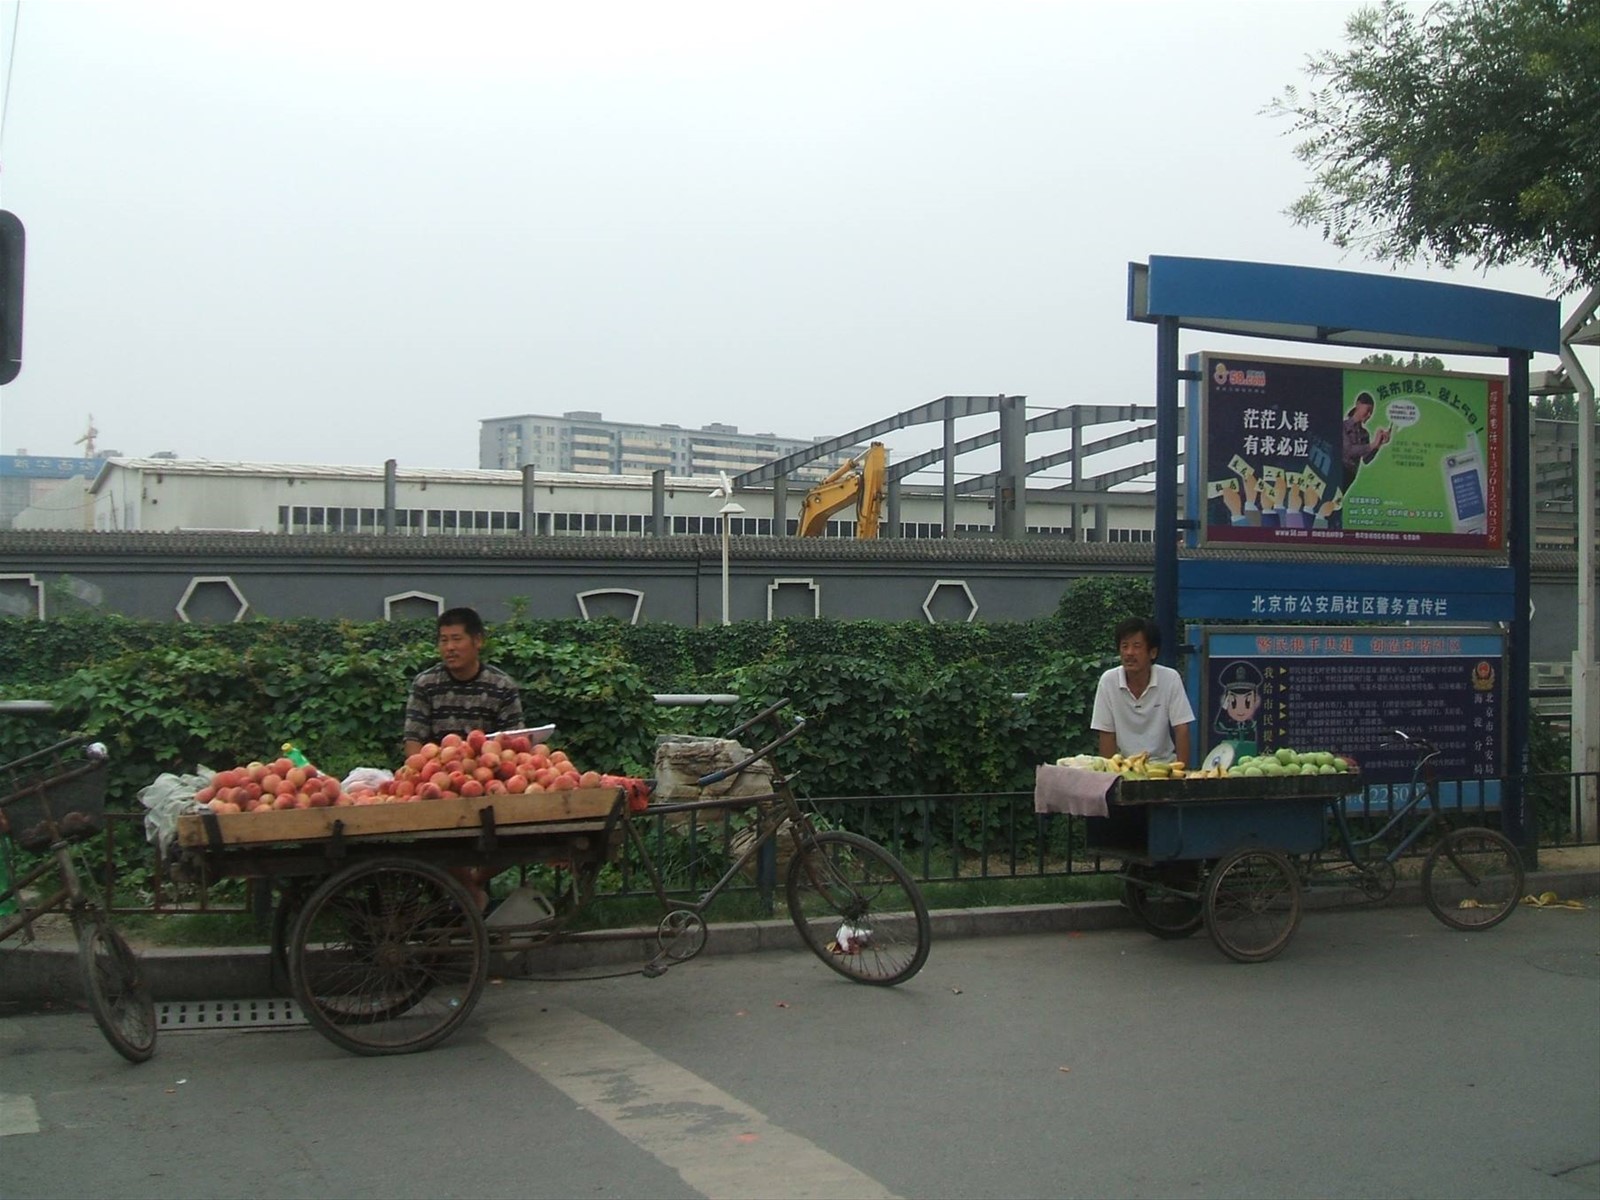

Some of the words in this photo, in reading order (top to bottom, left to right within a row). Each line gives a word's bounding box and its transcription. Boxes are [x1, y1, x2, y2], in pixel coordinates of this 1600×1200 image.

[1243, 408, 1309, 431] 茫茫人海
[1243, 435, 1309, 457] 有求必应
[1252, 595, 1448, 616] 北京市公安局社区警务宣传栏
[1473, 693, 1483, 774] 海淀分局
[1485, 693, 1495, 774] 北京市公安局
